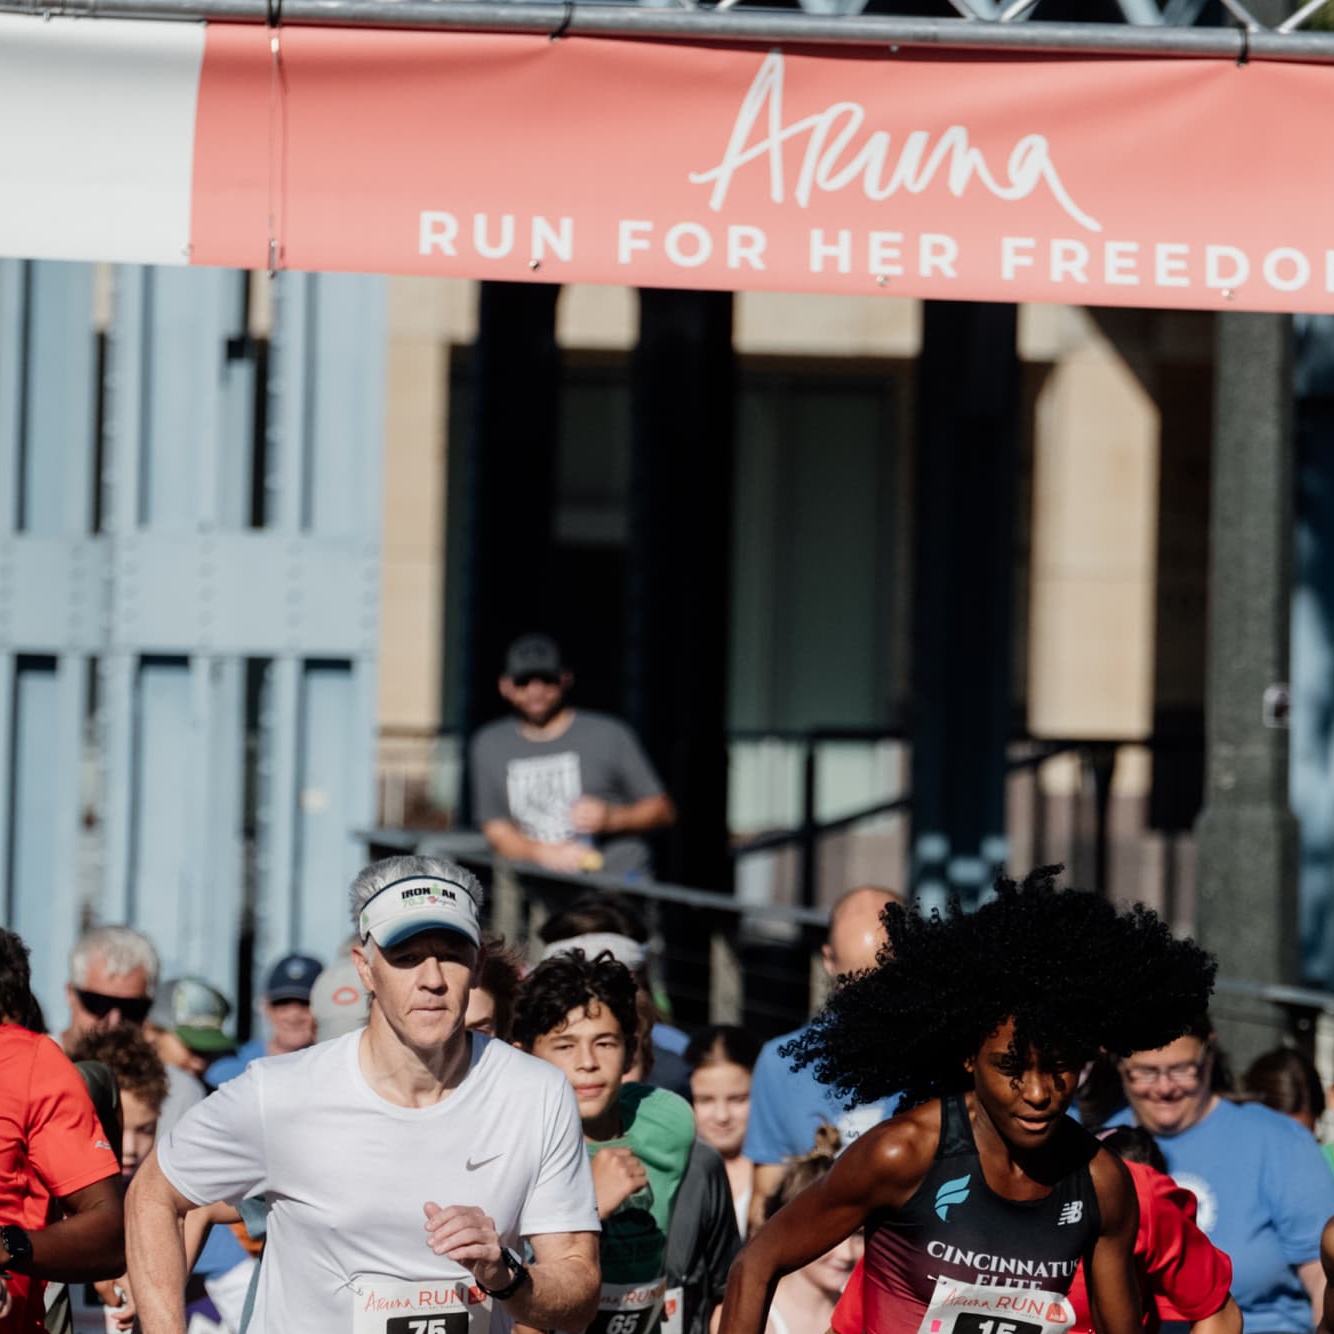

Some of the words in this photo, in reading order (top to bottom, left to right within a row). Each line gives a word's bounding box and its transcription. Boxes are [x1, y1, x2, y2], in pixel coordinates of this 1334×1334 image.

[418, 210, 577, 264] RUN
[617, 219, 768, 273] FOR
[807, 228, 964, 280] HER
[418, 1287, 465, 1306] RUN
[995, 1296, 1045, 1316] RUN
